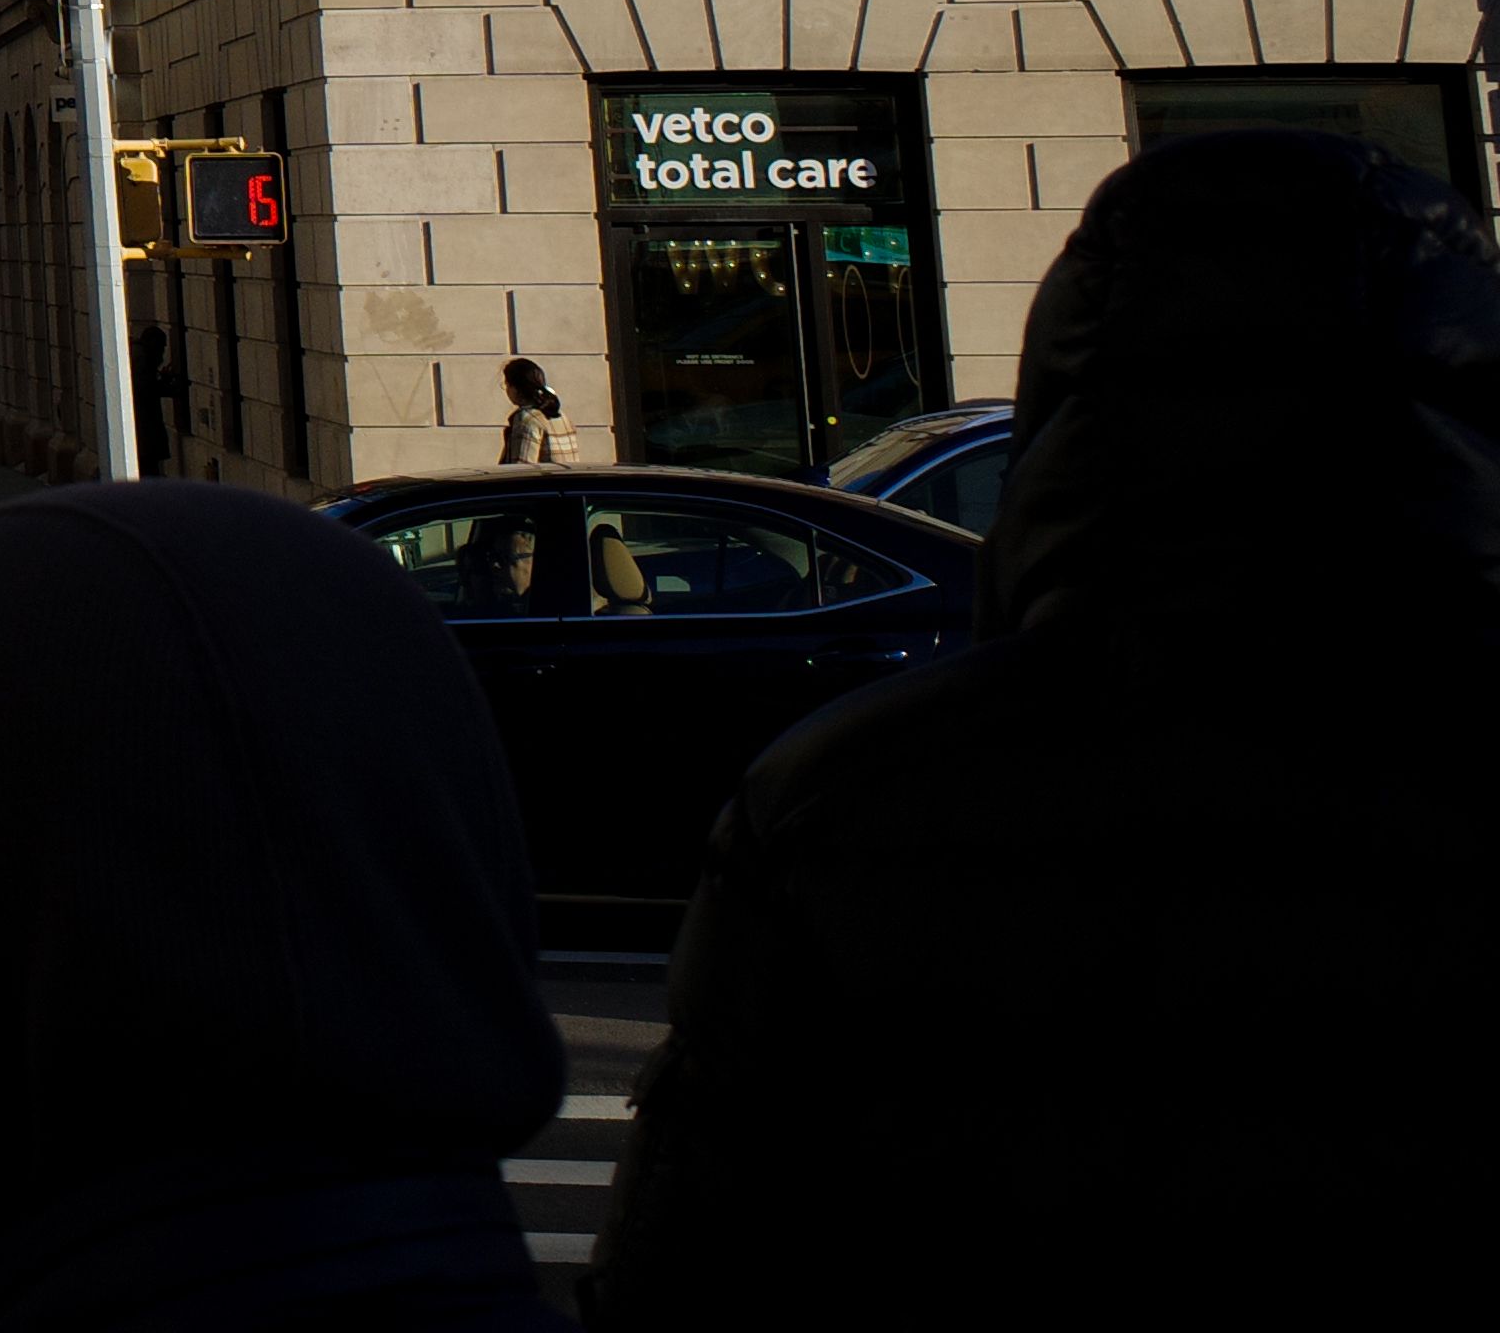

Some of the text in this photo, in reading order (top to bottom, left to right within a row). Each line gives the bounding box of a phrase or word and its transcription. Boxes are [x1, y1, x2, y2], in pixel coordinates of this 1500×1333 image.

[631, 107, 775, 144] vetco
[635, 150, 878, 190] total care
